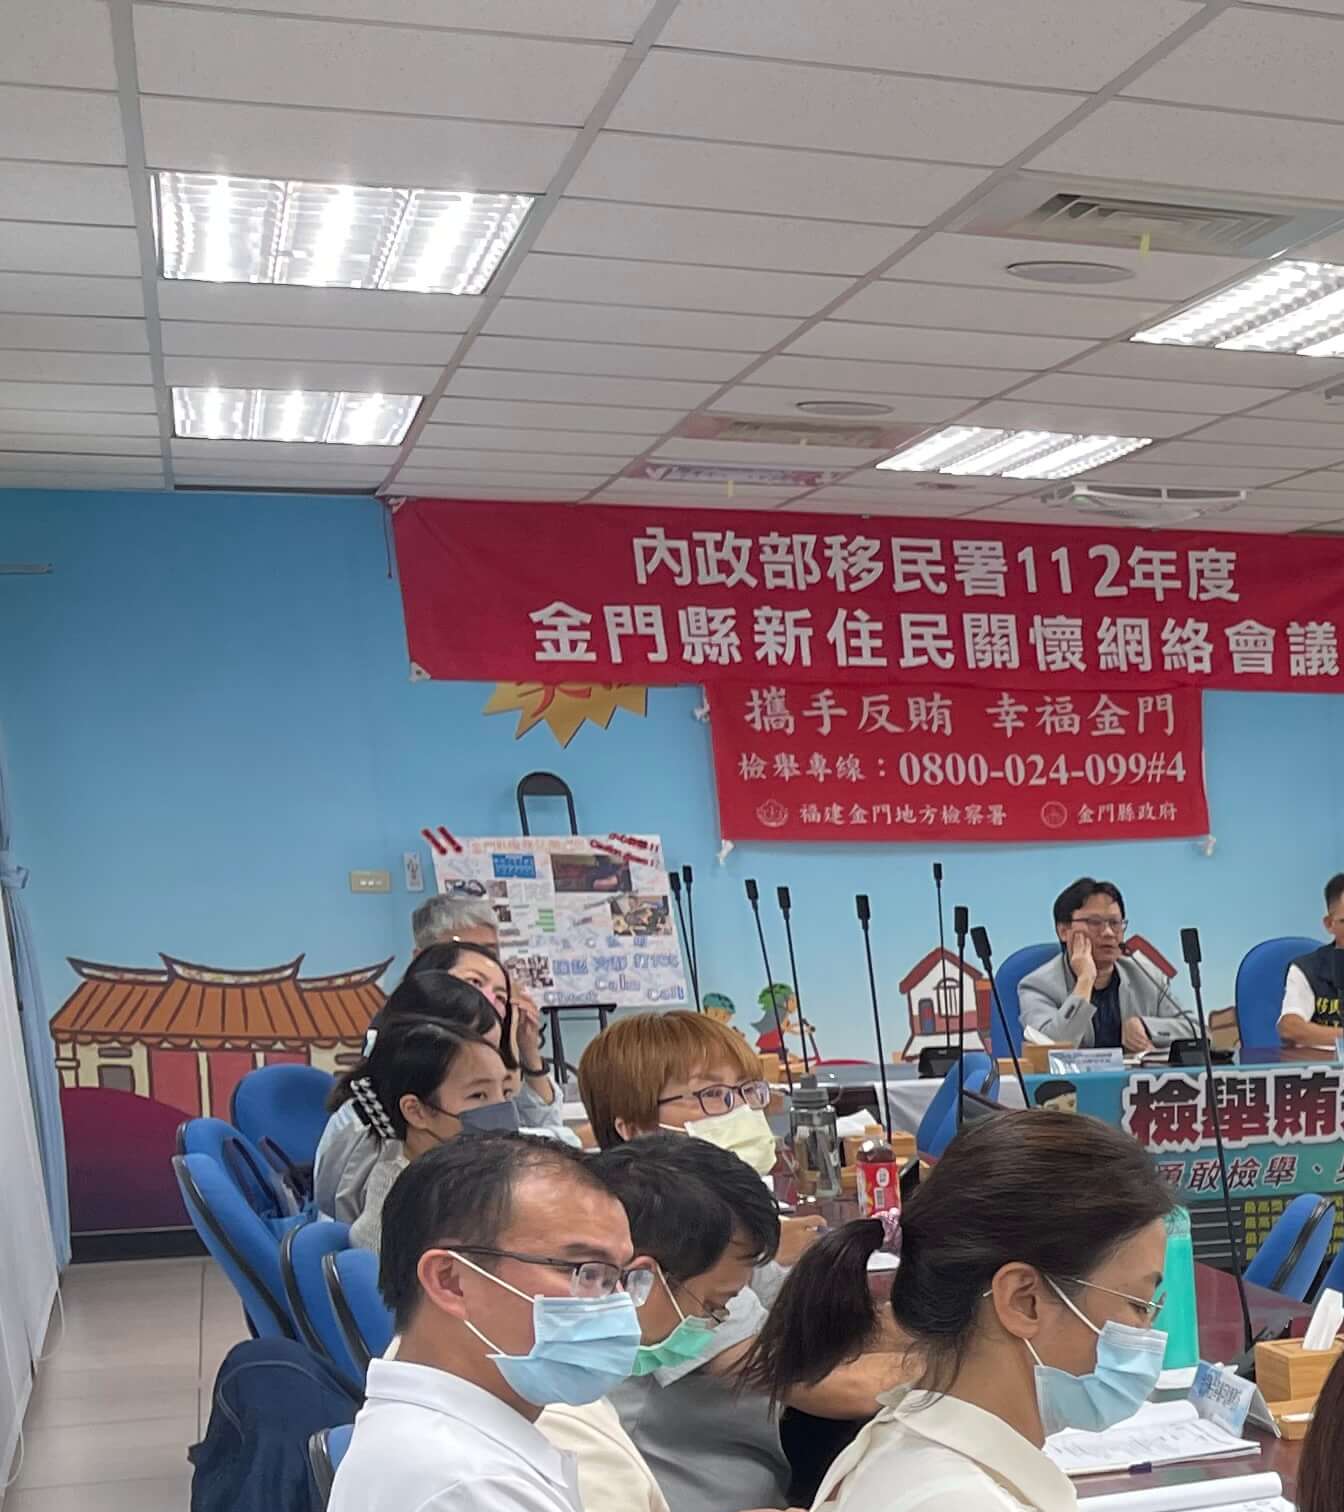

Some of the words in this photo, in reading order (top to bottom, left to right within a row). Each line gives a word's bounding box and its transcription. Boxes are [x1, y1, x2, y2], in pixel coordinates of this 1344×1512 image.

[632, 526, 1241, 602] 內政部移民署112年度
[528, 600, 1341, 678] 金門縣新住民關懷網絡會議
[744, 685, 953, 737] 攜手反賄
[985, 691, 1175, 738] 幸福金門
[799, 802, 1007, 826] 福建金門地方檢察署
[1077, 802, 1178, 825] 金門縣政府
